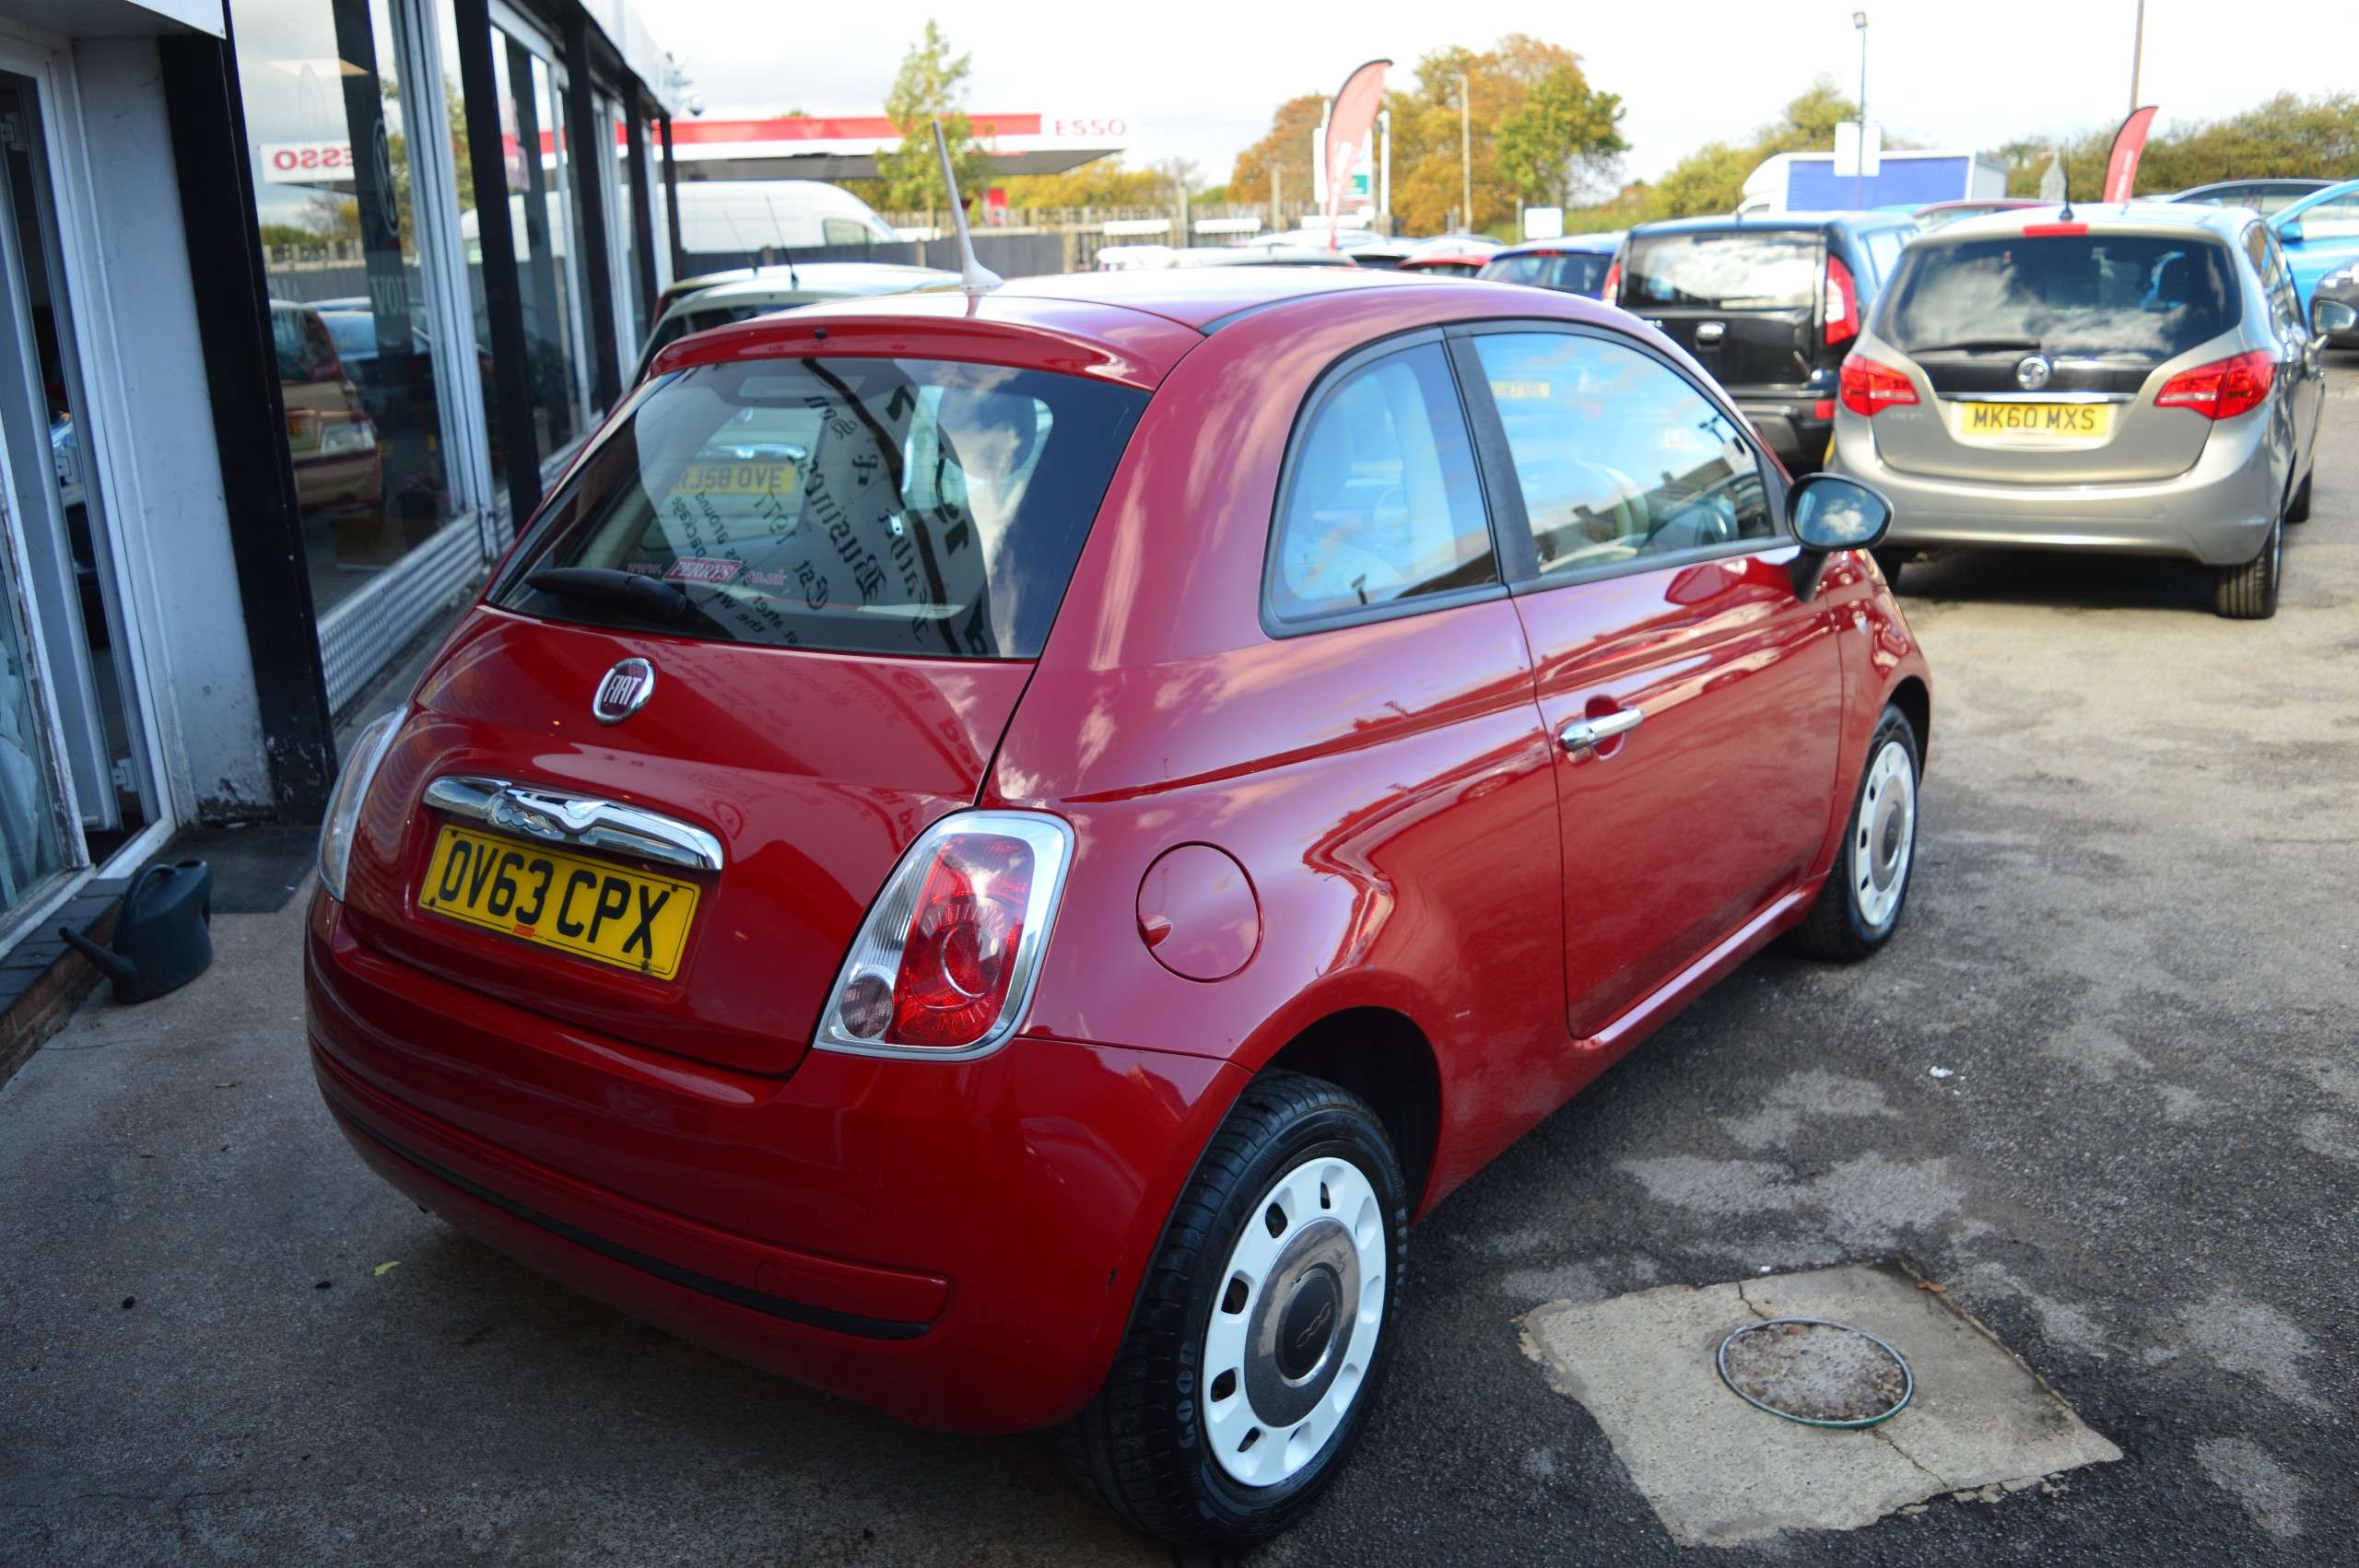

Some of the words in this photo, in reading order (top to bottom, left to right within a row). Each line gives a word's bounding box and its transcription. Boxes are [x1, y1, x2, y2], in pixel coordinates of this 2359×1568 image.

[1054, 119, 1126, 136] ESSO
[1974, 405, 2037, 427] MK60
[2046, 408, 2095, 430] MXS
[737, 466, 783, 489] OVE
[604, 674, 642, 706] FIAT
[439, 839, 555, 925] OV63
[557, 869, 671, 960] CPX
